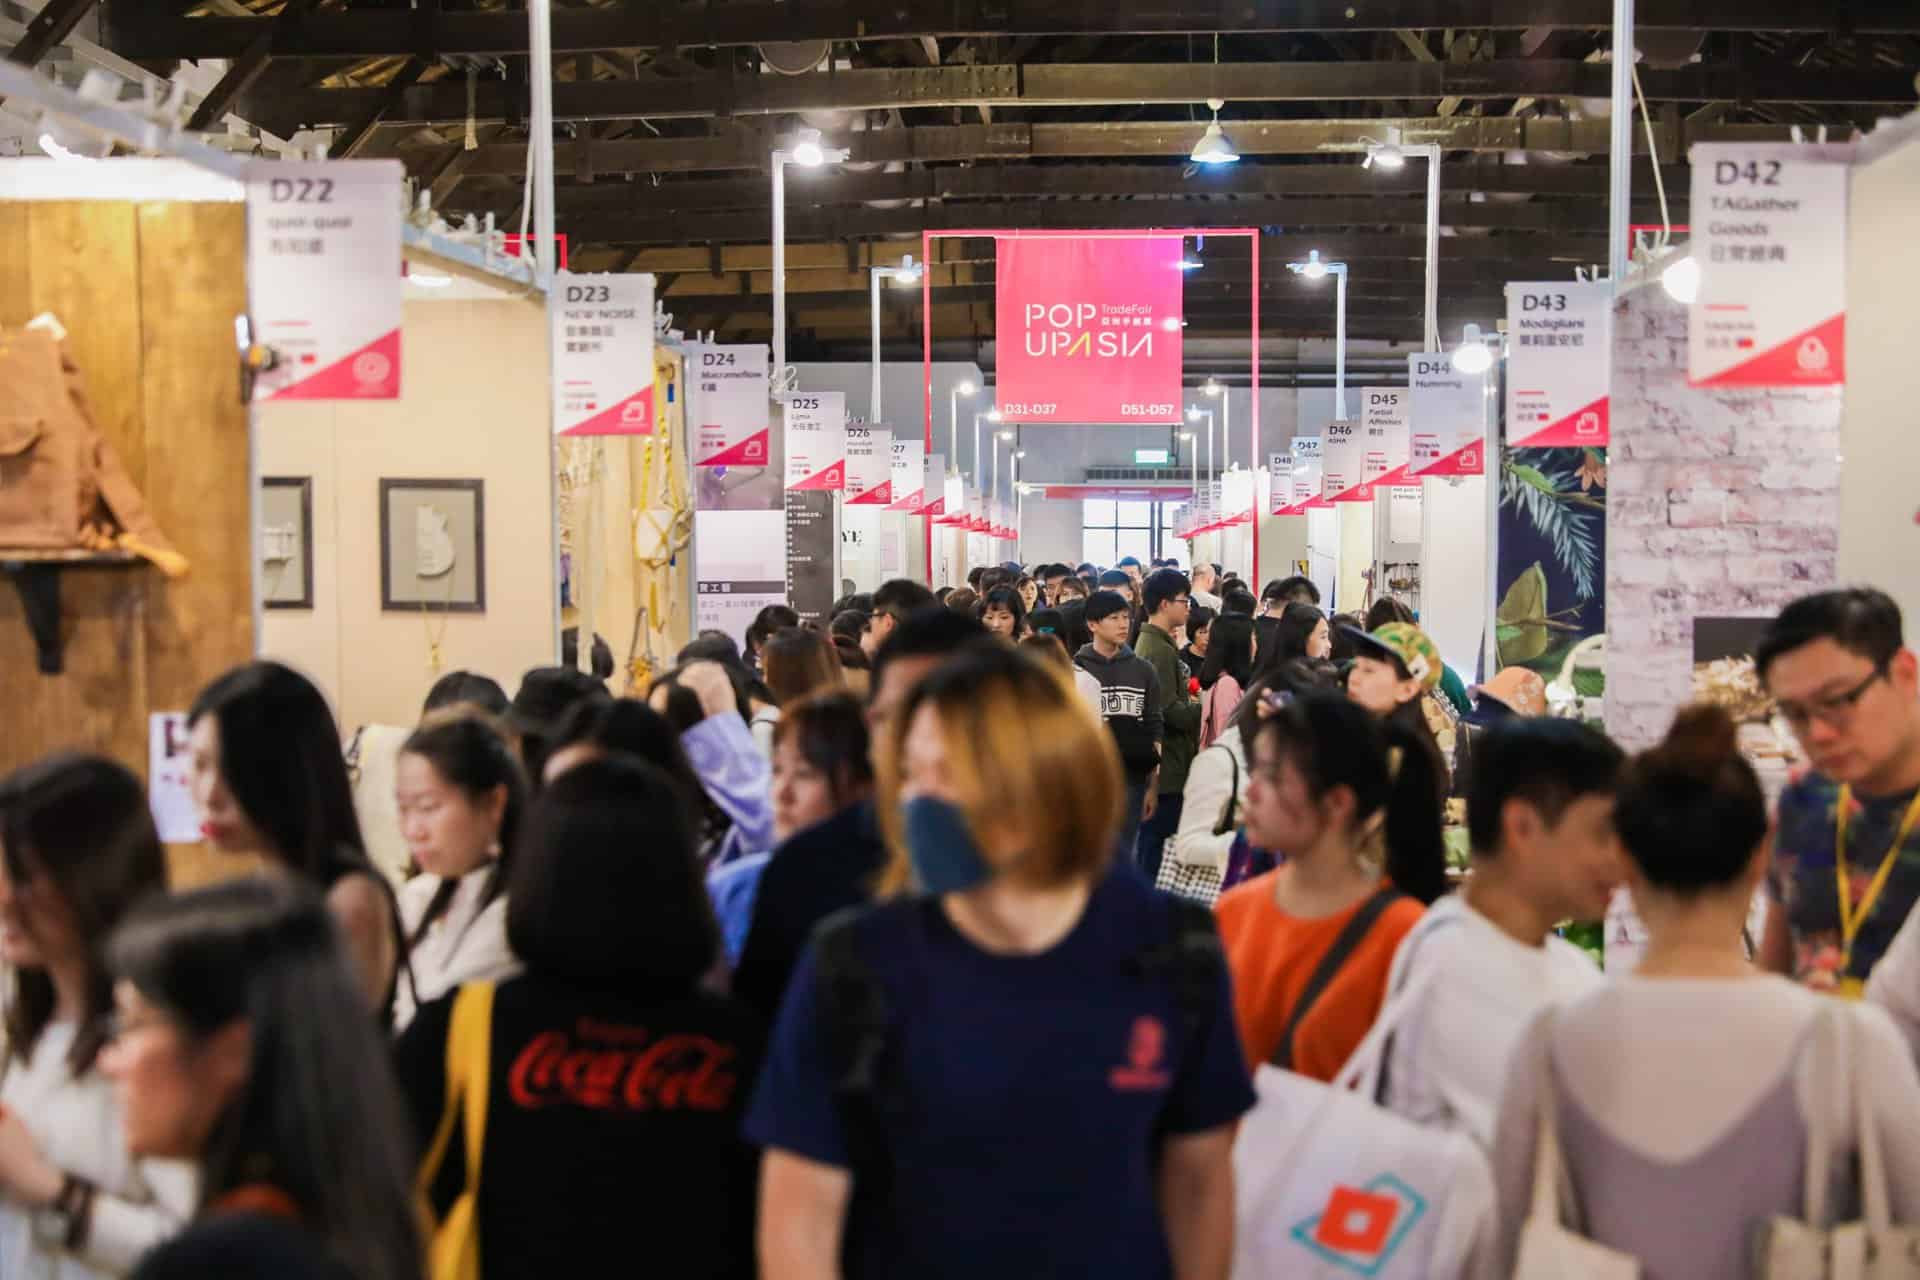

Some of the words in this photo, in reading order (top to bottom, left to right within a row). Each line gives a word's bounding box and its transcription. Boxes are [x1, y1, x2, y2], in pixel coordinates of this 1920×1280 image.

[1714, 160, 1782, 186] D42
[271, 177, 334, 202] D22
[567, 286, 609, 302] D23
[1522, 294, 1566, 312] D43
[1025, 303, 1096, 328] POP
[1101, 304, 1152, 315] TradeFair
[703, 353, 736, 366] D24
[1417, 361, 1451, 375] D44
[793, 399, 819, 409] D25
[1371, 394, 1398, 405] D45
[1004, 403, 1057, 415] D31-D37
[1121, 403, 1174, 415] D51-D57
[848, 428, 871, 438] D26
[1329, 426, 1352, 436] D46
[892, 445, 905, 453] 27
[1298, 442, 1318, 450] D47
